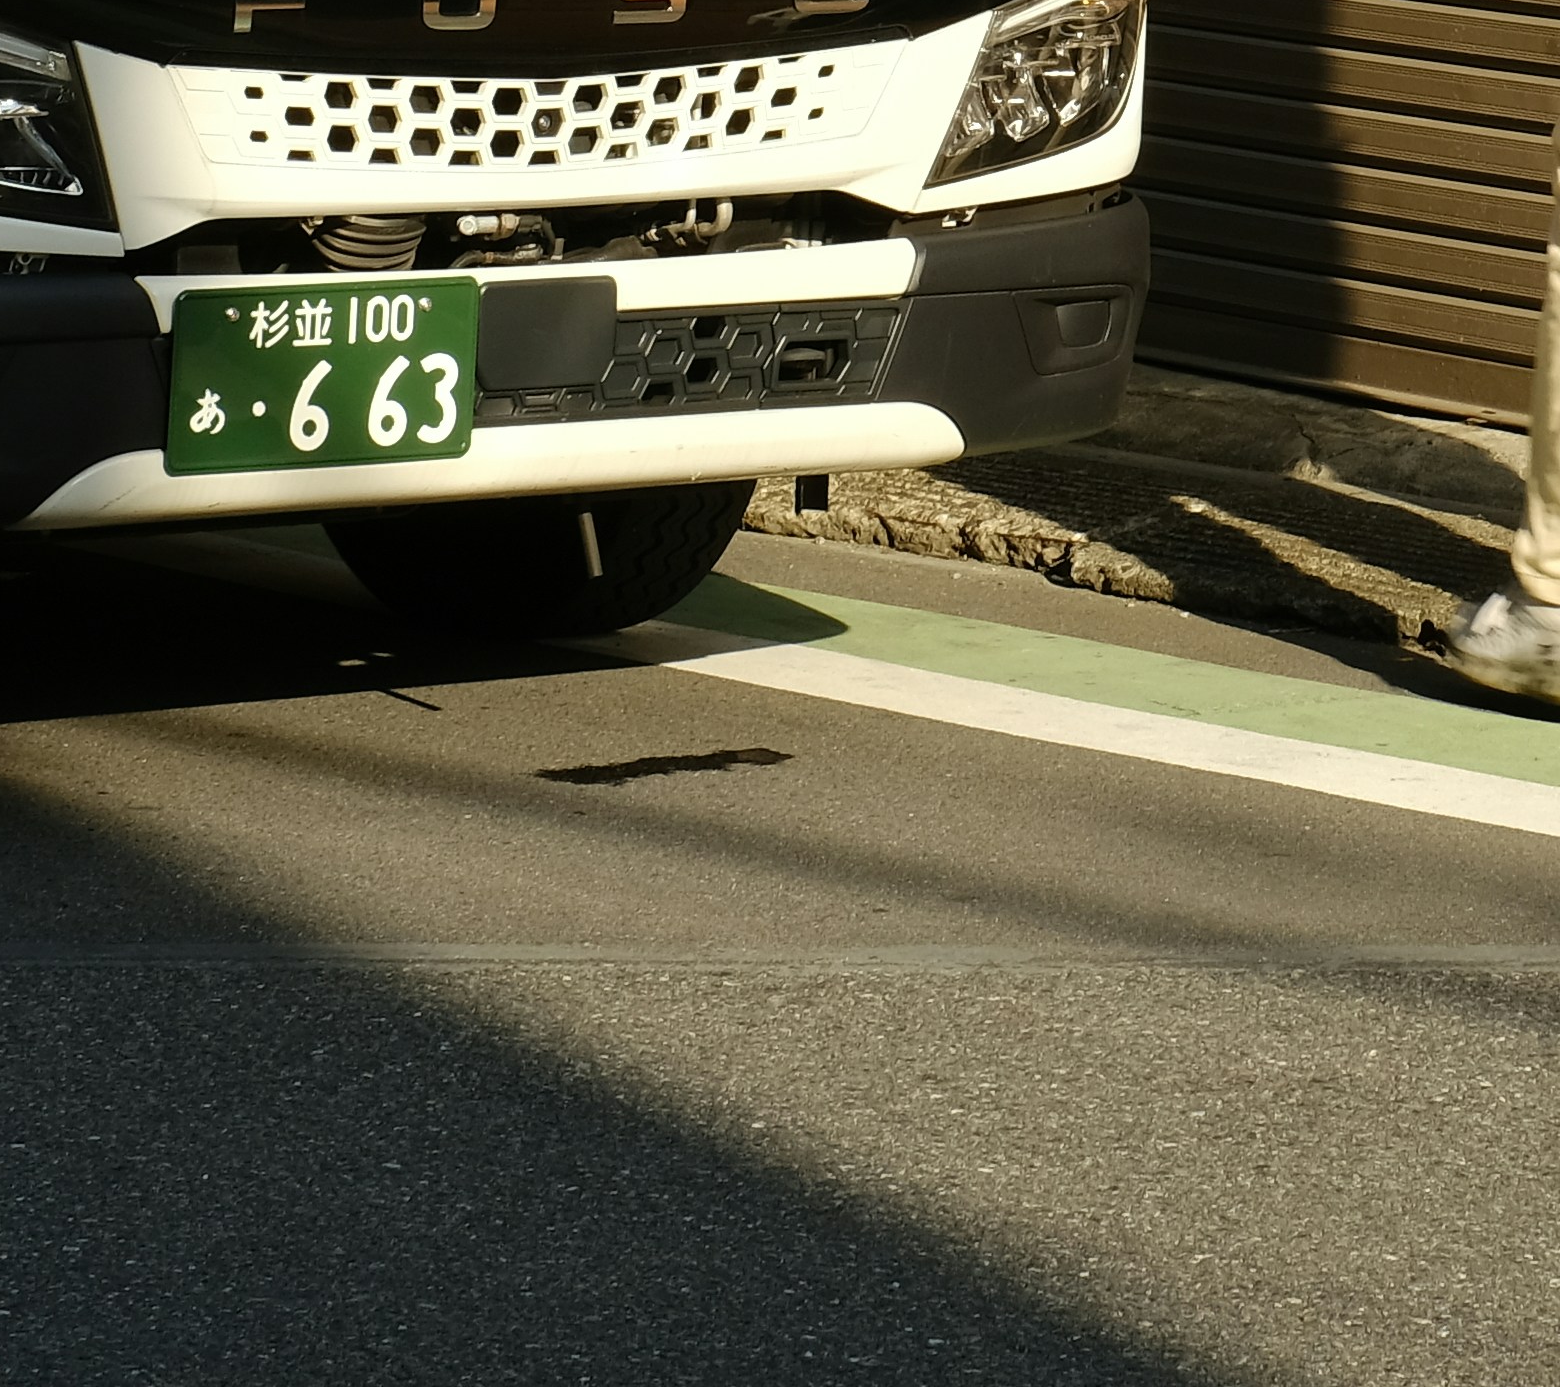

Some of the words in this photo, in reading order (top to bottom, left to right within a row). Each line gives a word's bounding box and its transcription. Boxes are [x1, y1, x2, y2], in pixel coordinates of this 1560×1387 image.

[248, 298, 333, 348] 杉並
[347, 294, 415, 345] 100
[189, 387, 226, 434] あ
